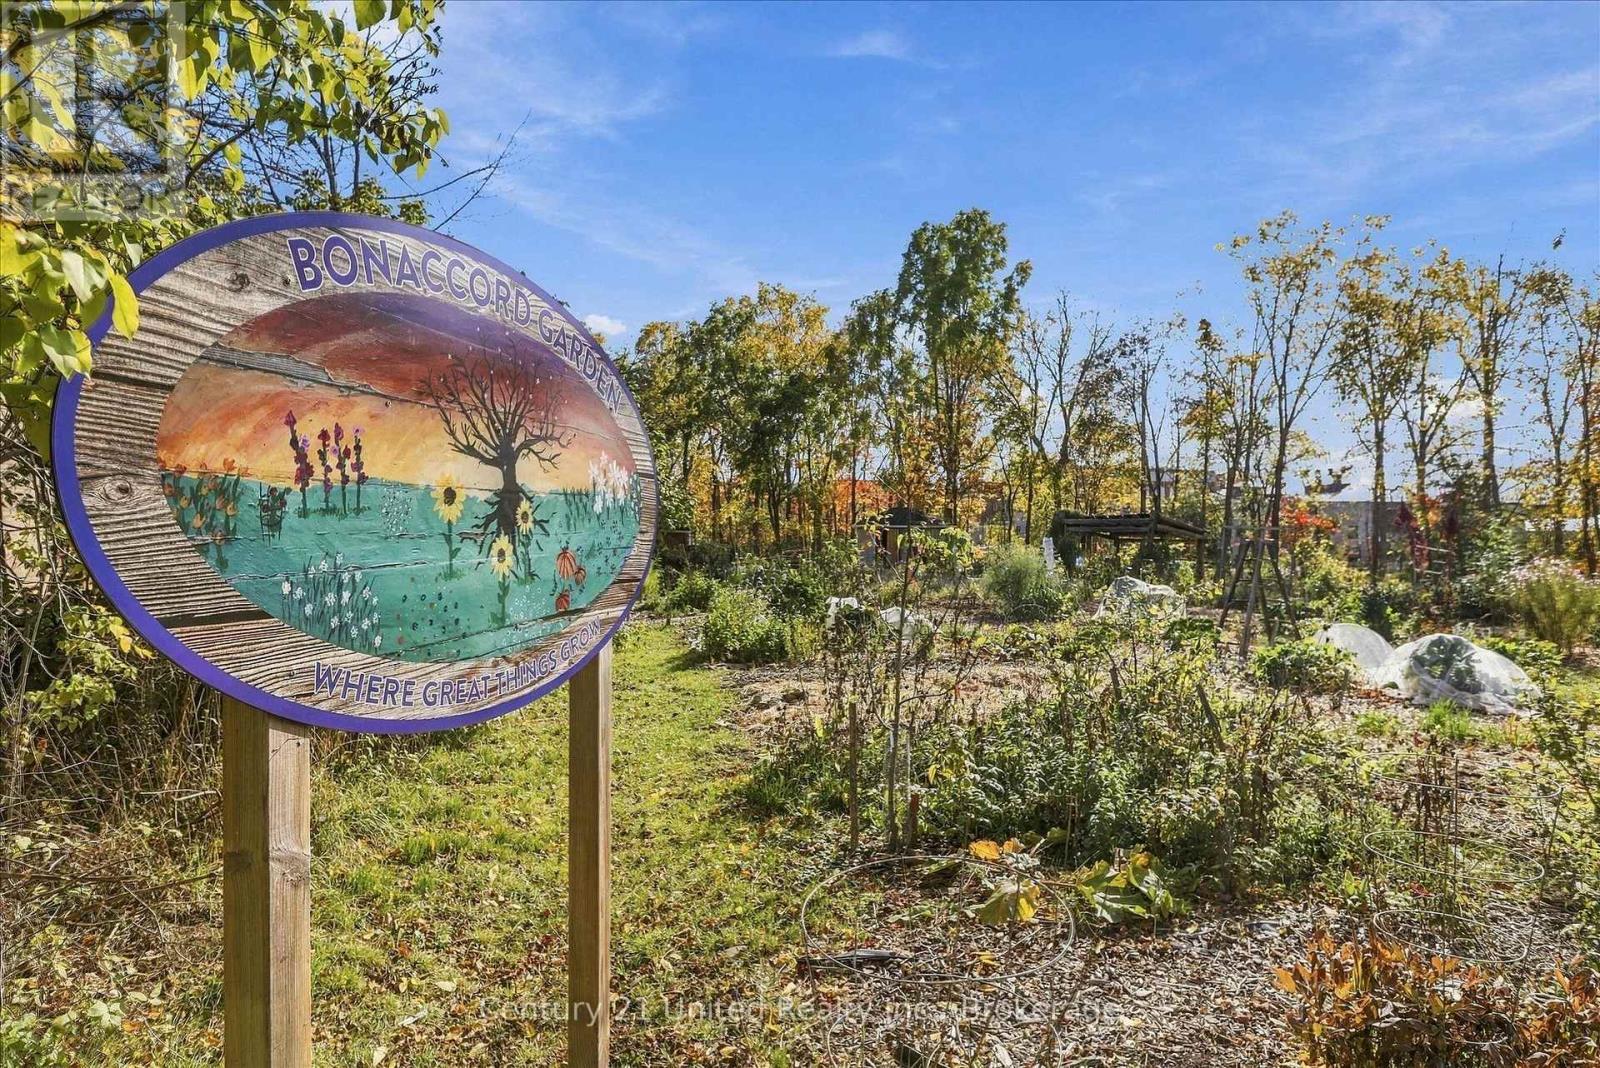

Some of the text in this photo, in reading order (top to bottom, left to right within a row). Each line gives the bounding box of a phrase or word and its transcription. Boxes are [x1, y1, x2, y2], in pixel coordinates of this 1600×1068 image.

[287, 235, 624, 416] BONACCORD GARDEN
[313, 616, 601, 707] WHERE GREAT THINGS GROW
